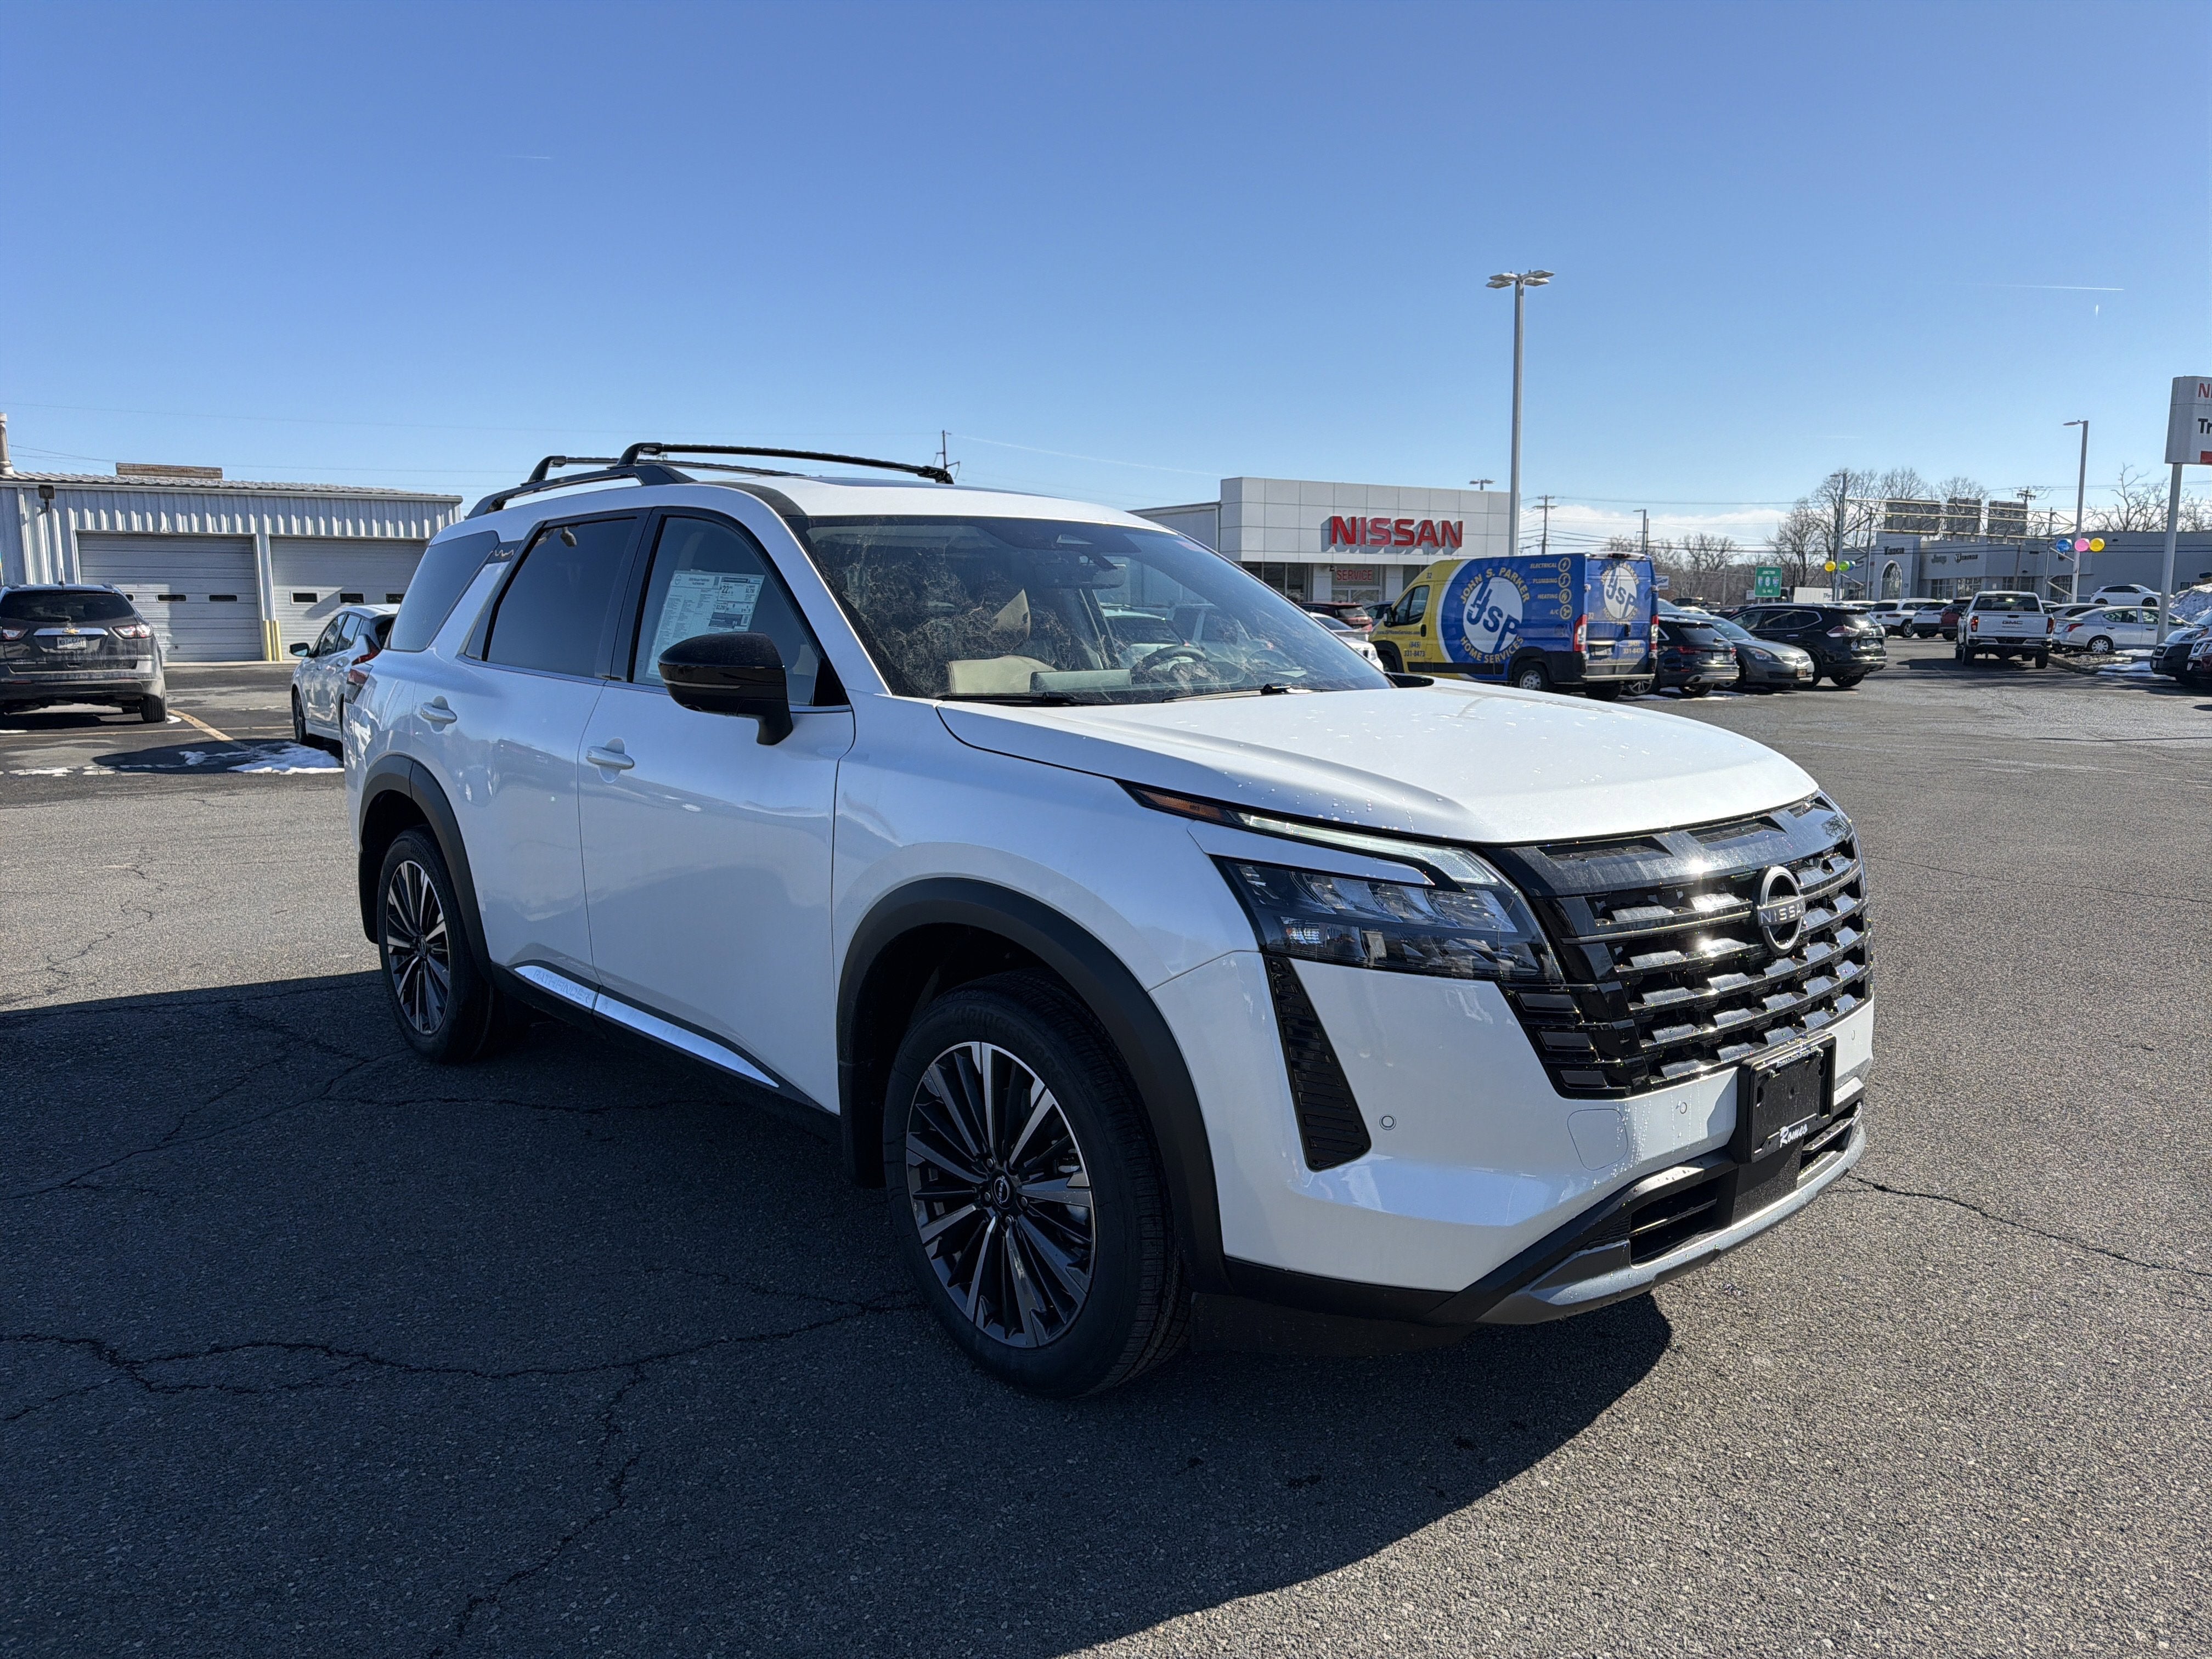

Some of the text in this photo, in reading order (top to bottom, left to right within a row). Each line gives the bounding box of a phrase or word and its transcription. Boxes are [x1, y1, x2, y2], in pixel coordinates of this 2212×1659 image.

[1331, 516, 1463, 548] NISSAN
[1336, 569, 1373, 582] SERVICE
[1460, 567, 1530, 603] JOHN S. PARKER
[1606, 575, 1637, 619] JSP
[1466, 586, 1520, 653] JSP
[1460, 635, 1523, 663] HOME SERVICES
[1760, 901, 1806, 924] NISSAN
[533, 969, 591, 1003] PATHFINDER
